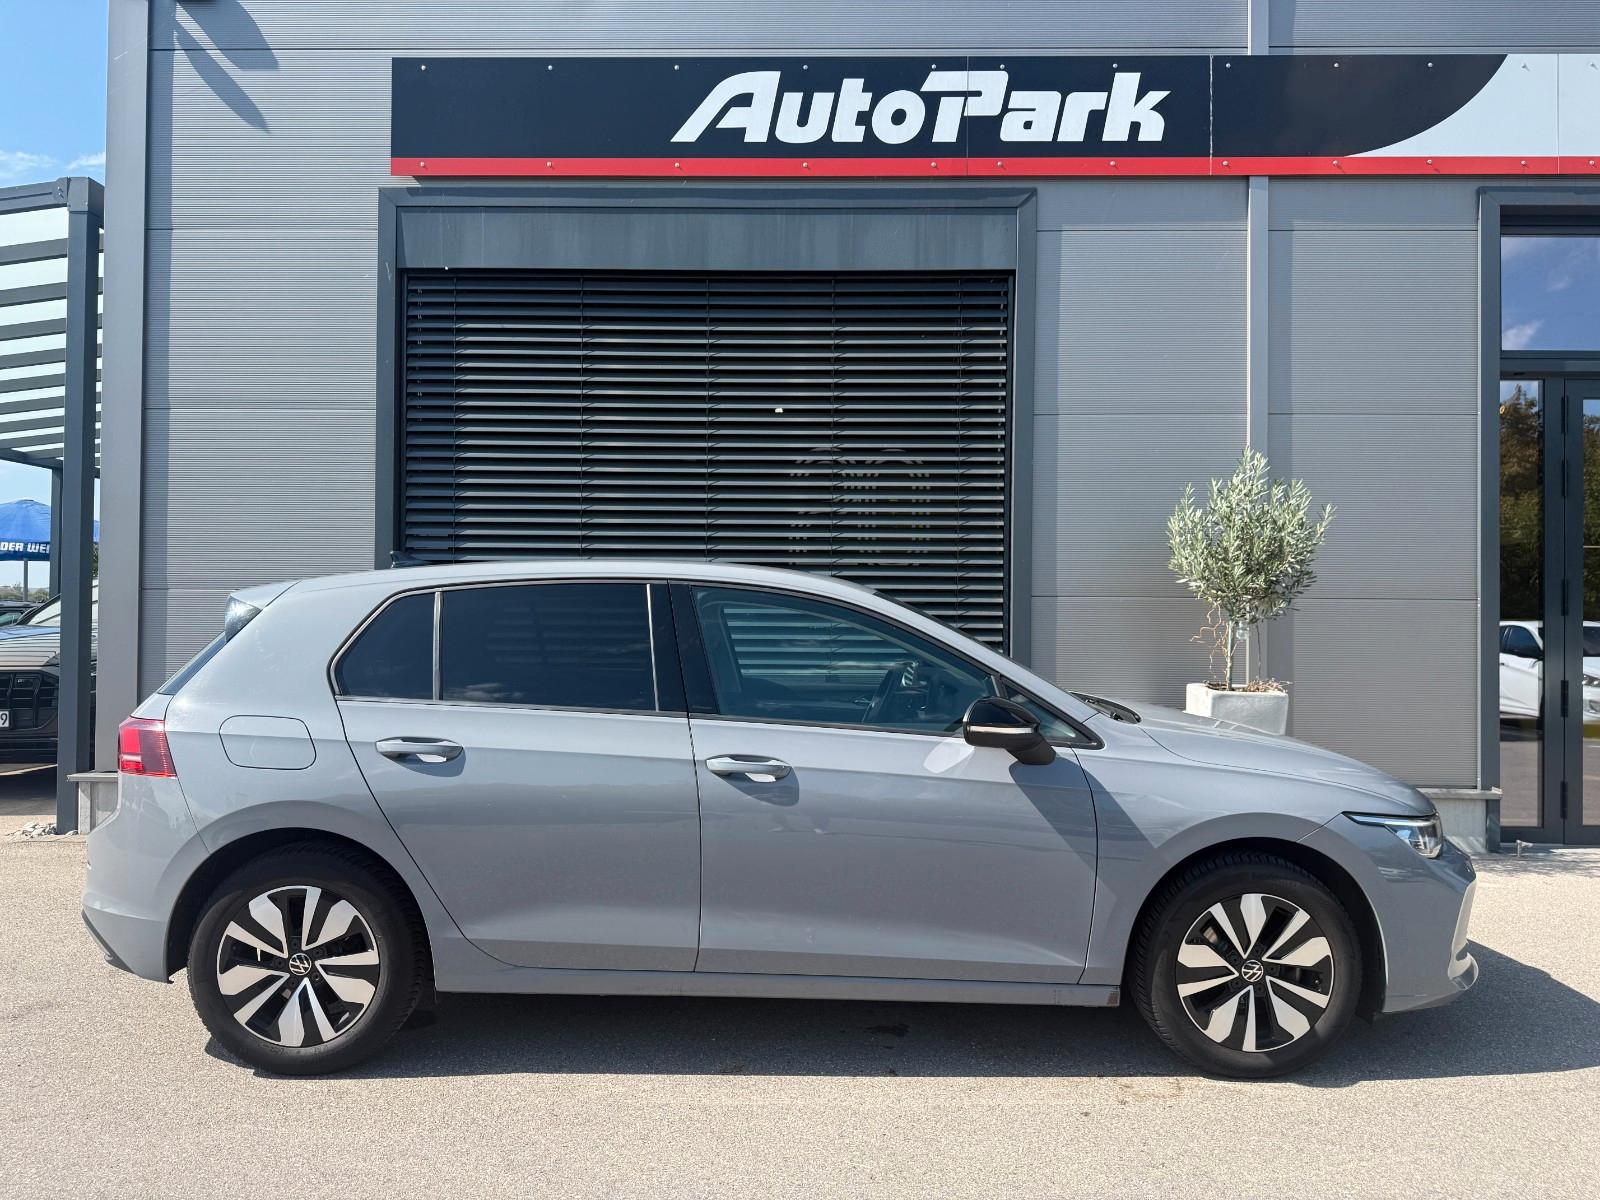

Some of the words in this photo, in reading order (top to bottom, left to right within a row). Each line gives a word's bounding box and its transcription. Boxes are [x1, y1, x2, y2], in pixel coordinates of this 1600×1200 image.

[670, 70, 1171, 144] AutoPark
[0, 541, 24, 551] DER
[0, 712, 8, 726] 9
